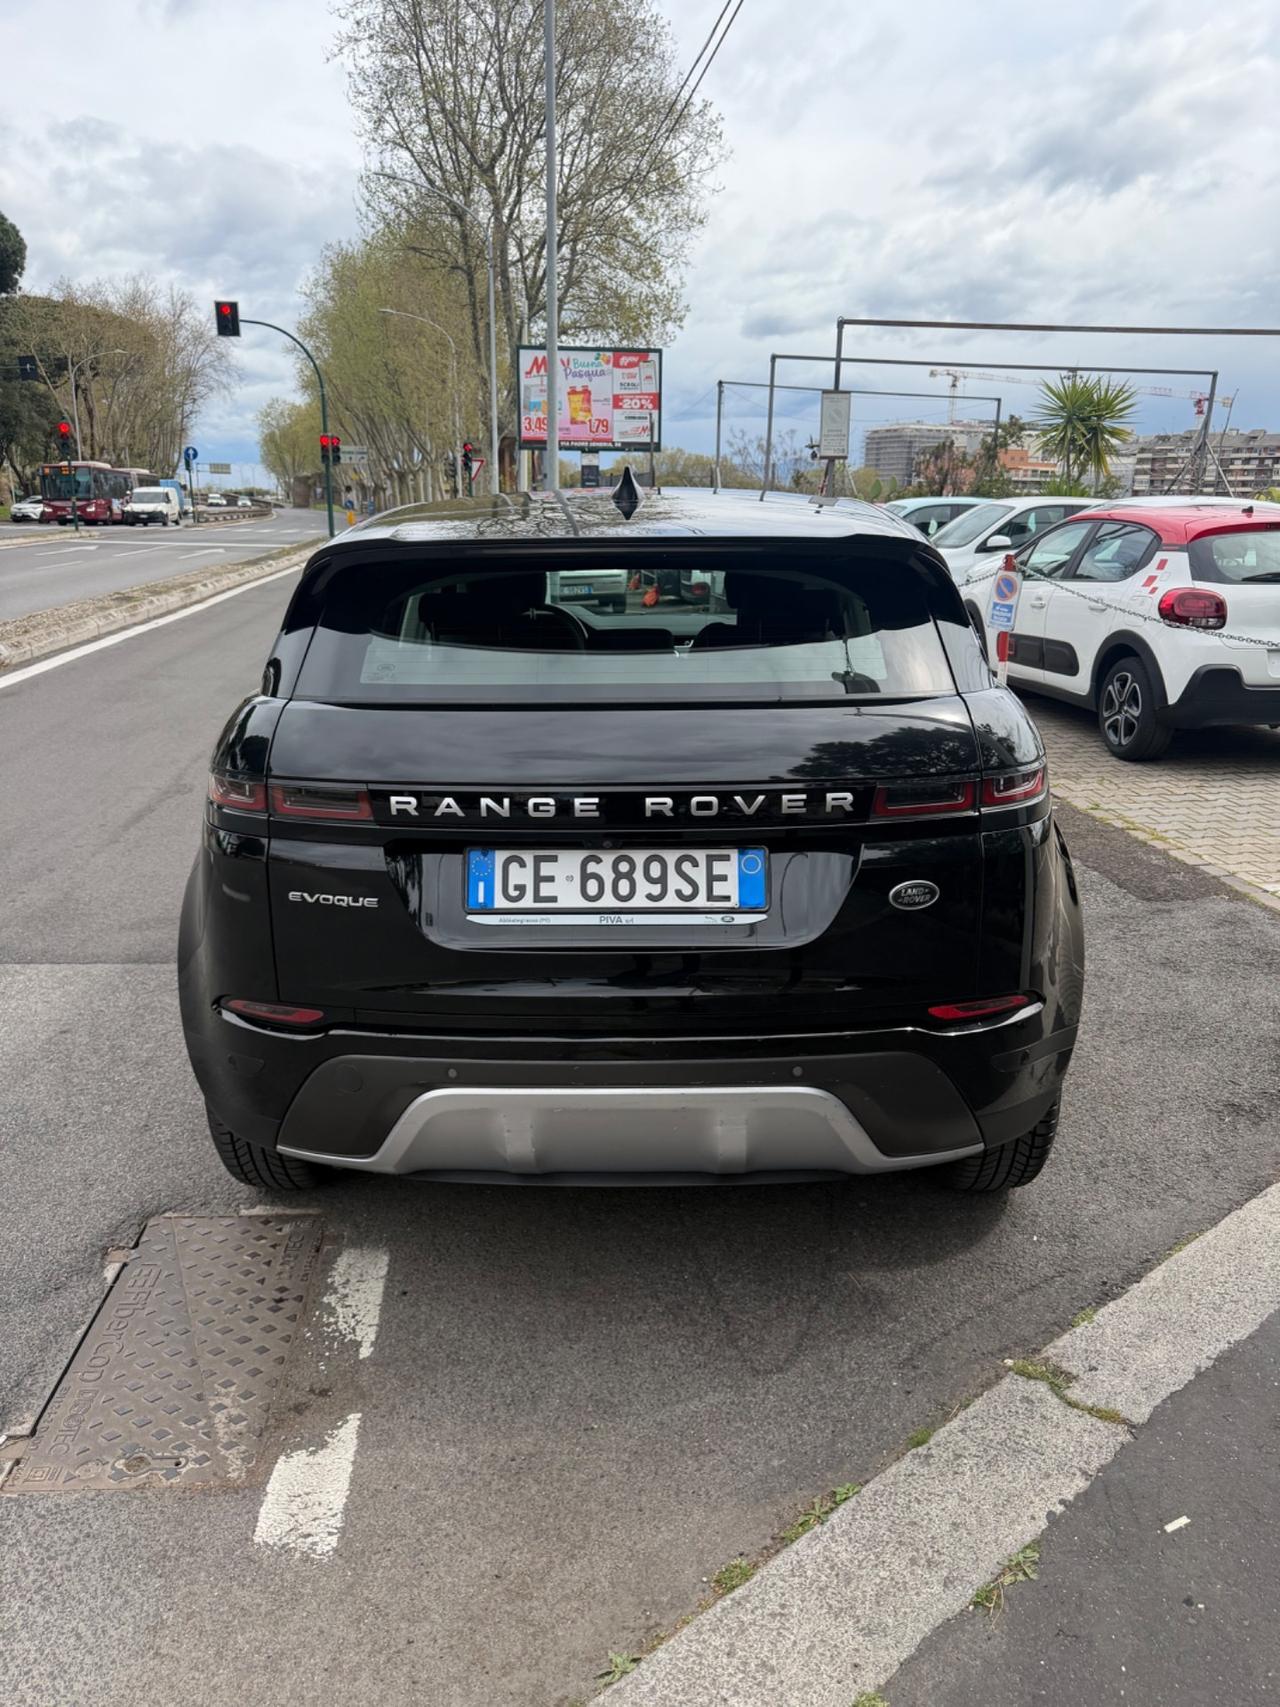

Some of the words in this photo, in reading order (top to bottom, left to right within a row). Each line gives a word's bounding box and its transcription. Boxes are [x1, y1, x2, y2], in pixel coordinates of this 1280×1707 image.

[572, 358, 603, 369] Buona
[563, 367, 607, 382] Pasqua
[618, 399, 653, 410] -20%
[389, 796, 600, 818] RANGE
[645, 792, 854, 818] ROVER
[501, 854, 559, 904] GE
[579, 853, 732, 903] 689SE
[901, 887, 924, 897] LAND
[288, 891, 379, 908] EVOQUE
[902, 894, 931, 904] ROVER
[599, 915, 623, 924] PIVA
